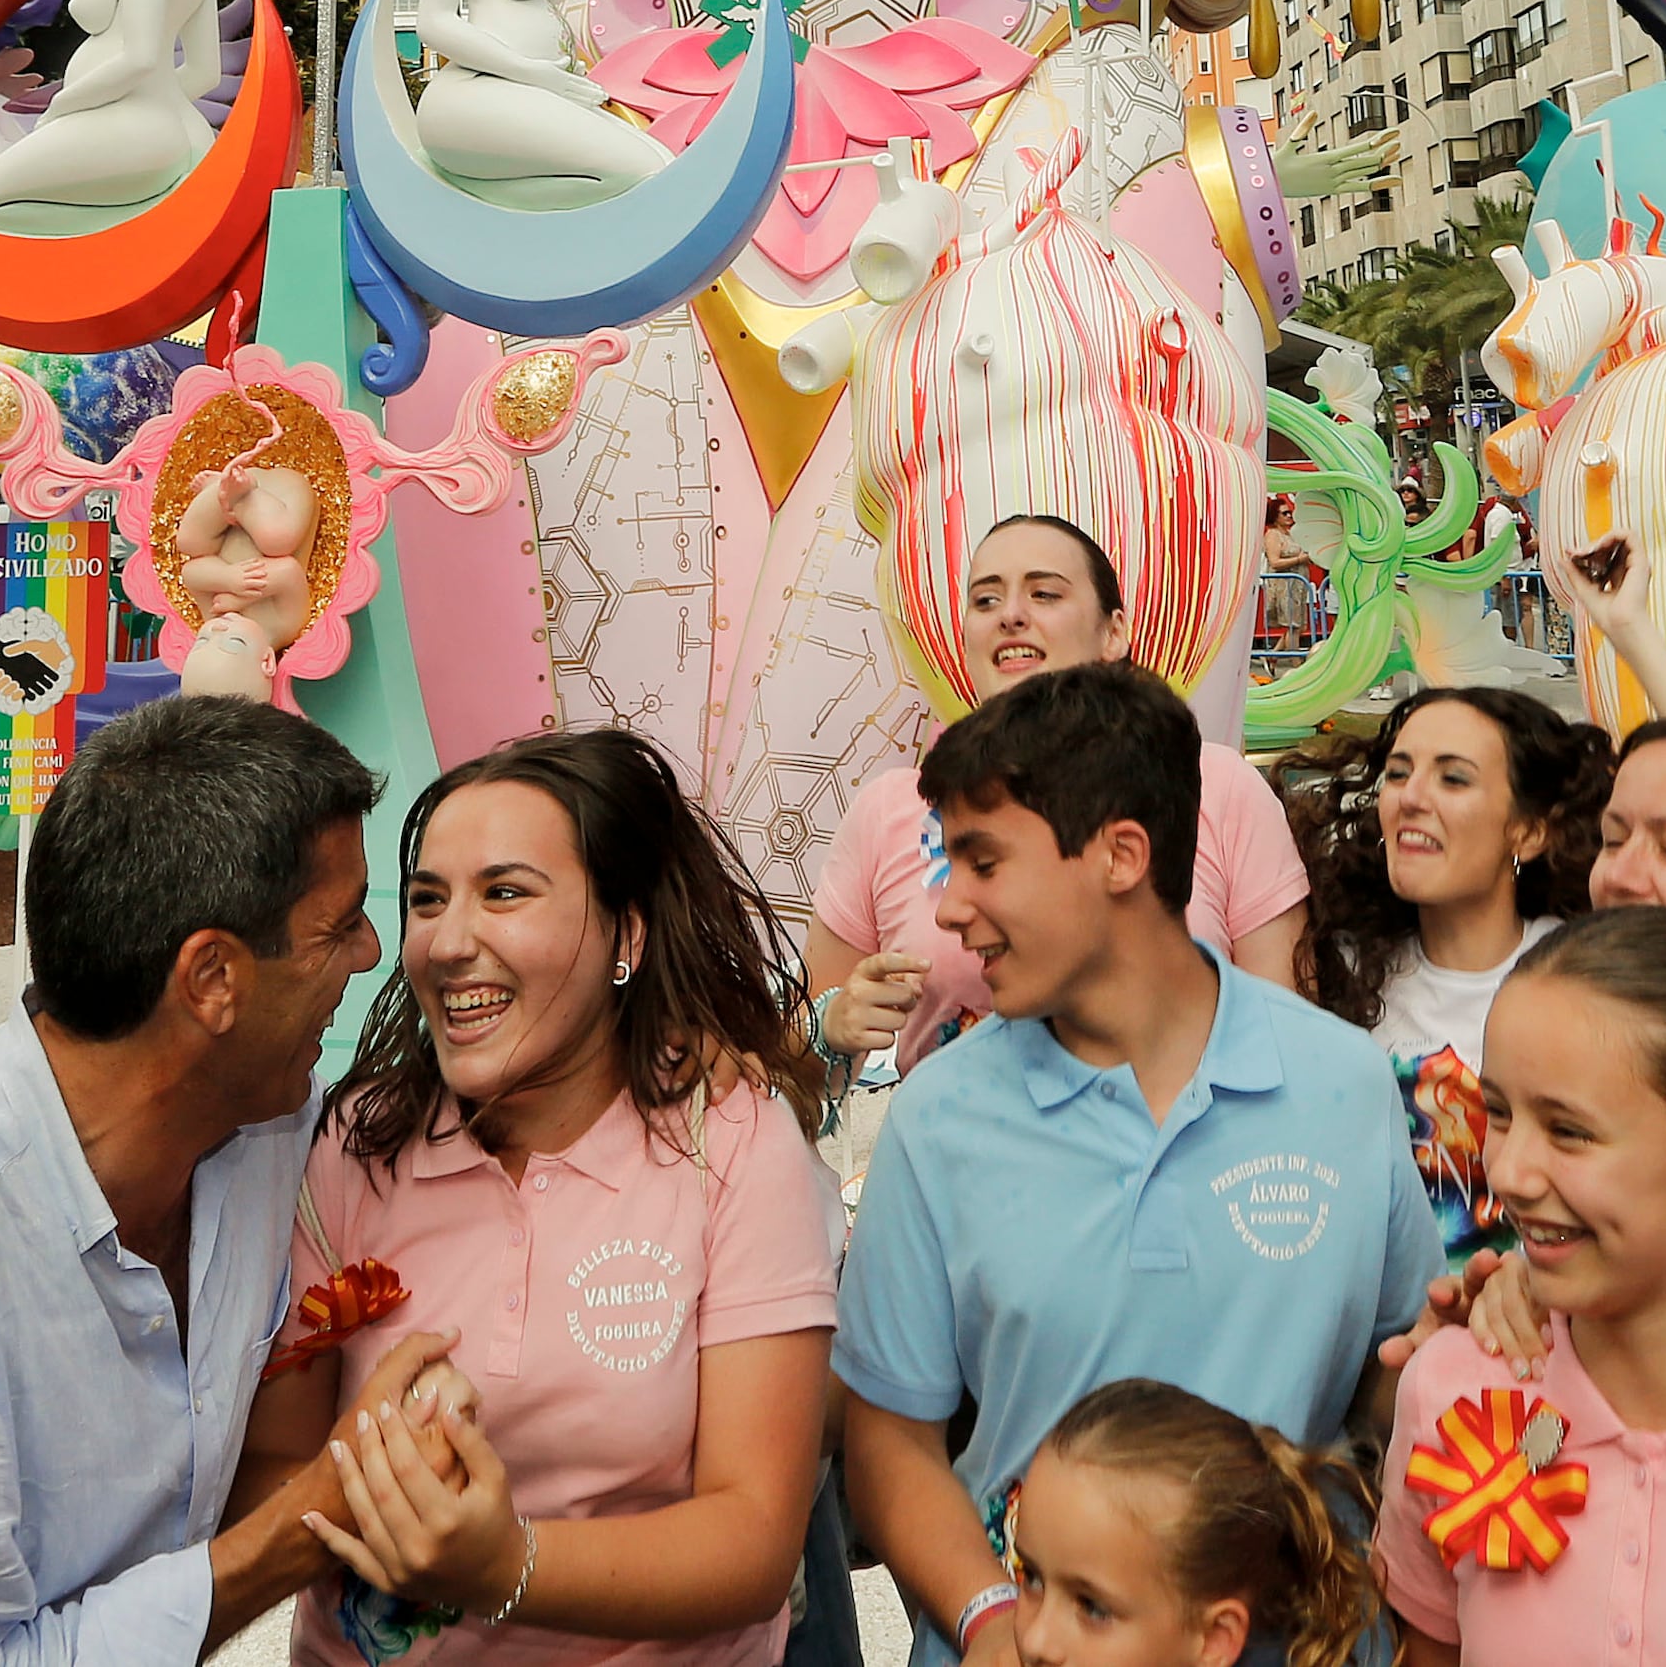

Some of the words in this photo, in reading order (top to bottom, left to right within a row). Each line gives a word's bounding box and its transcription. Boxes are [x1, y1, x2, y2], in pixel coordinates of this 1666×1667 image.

[1453, 384, 1497, 401] fac
[13, 531, 77, 554] HOMO
[2, 756, 31, 770] FENT
[12, 774, 36, 790] QUE
[16, 793, 28, 806] EL
[1209, 1153, 1285, 1197] PRESIDENTE
[1287, 1153, 1310, 1174] INF.
[1313, 1161, 1341, 1190] 2023
[1249, 1179, 1310, 1204] ÁLVARO
[1250, 1211, 1311, 1225] FOGUERA
[567, 1238, 635, 1289] BELLEZA
[639, 1239, 684, 1276] 2023
[583, 1279, 669, 1308] VANESSA
[594, 1320, 663, 1342] FOGUERA
